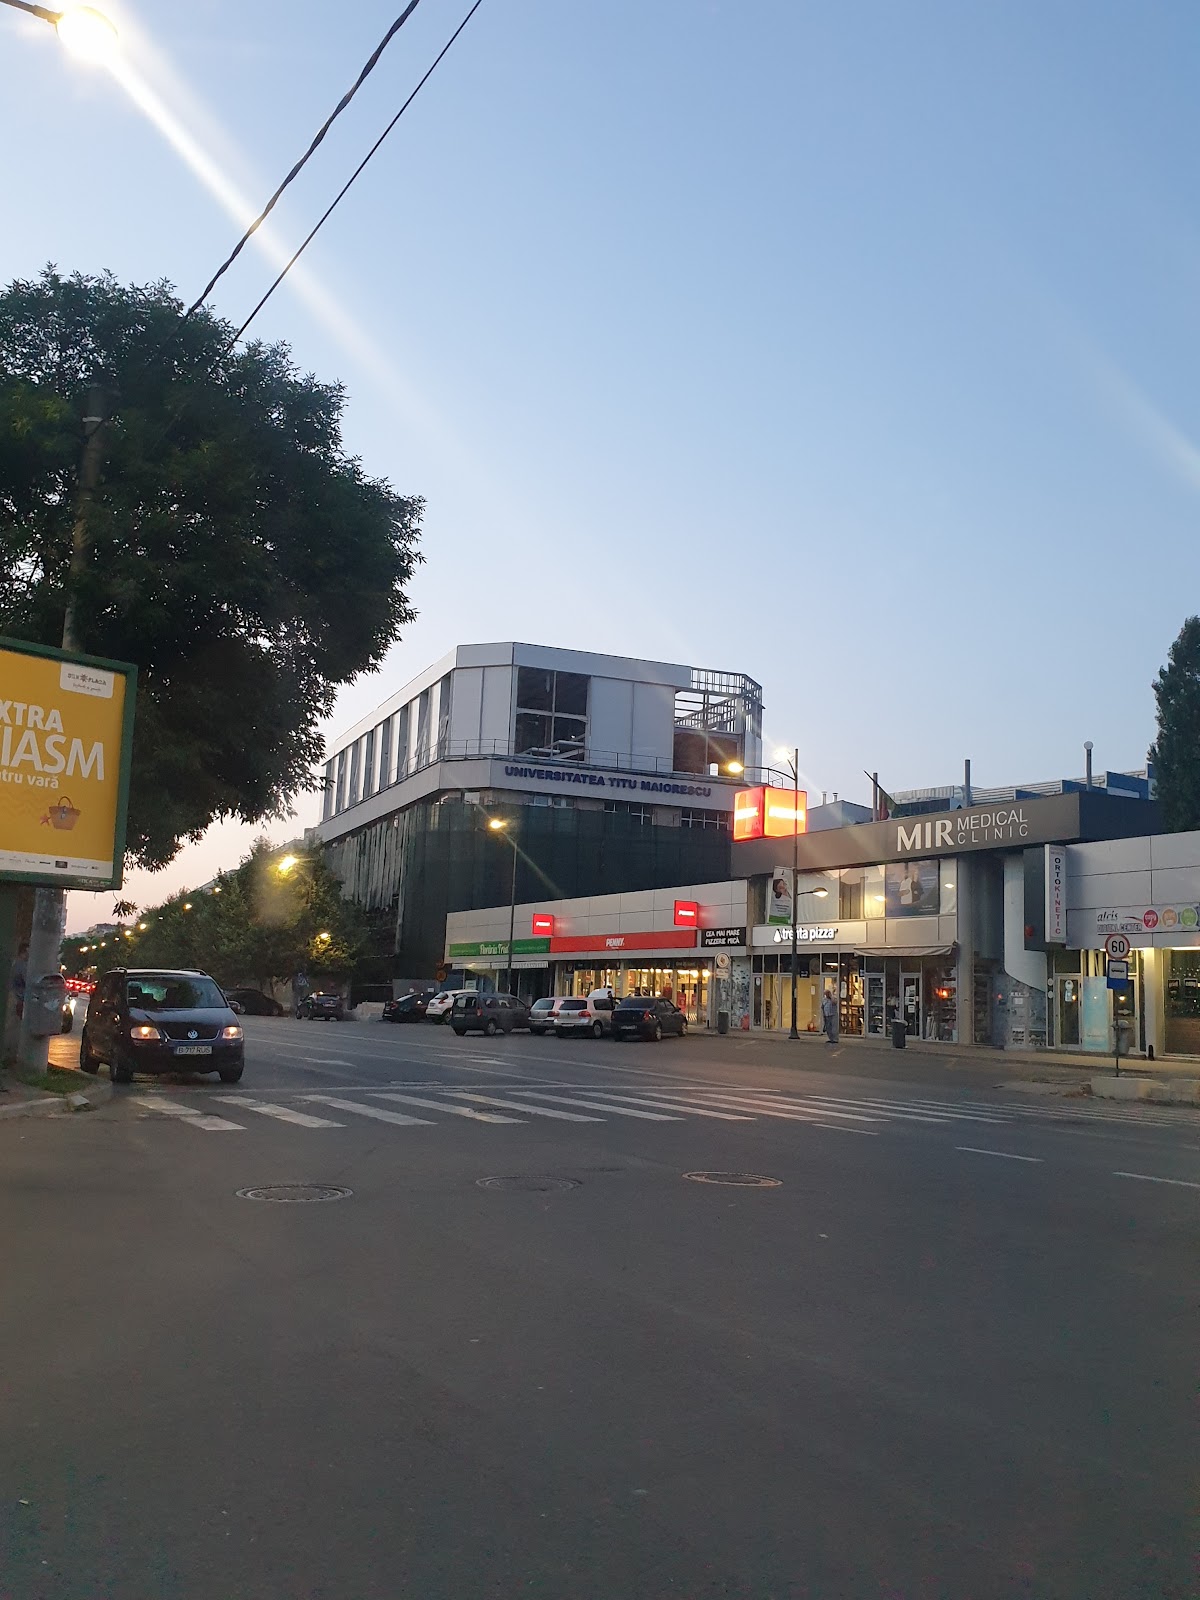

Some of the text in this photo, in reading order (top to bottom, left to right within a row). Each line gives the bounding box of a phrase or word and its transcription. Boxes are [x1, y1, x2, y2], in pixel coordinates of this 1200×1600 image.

[0, 768, 59, 789] tru vară
[504, 765, 712, 798] UNIVERSITATEA TITU MAIORESCU
[897, 808, 1028, 852] MIR MEDICAL
[957, 823, 1029, 845] CLINIC
[809, 926, 835, 942] pizza
[1111, 940, 1125, 953] 60
